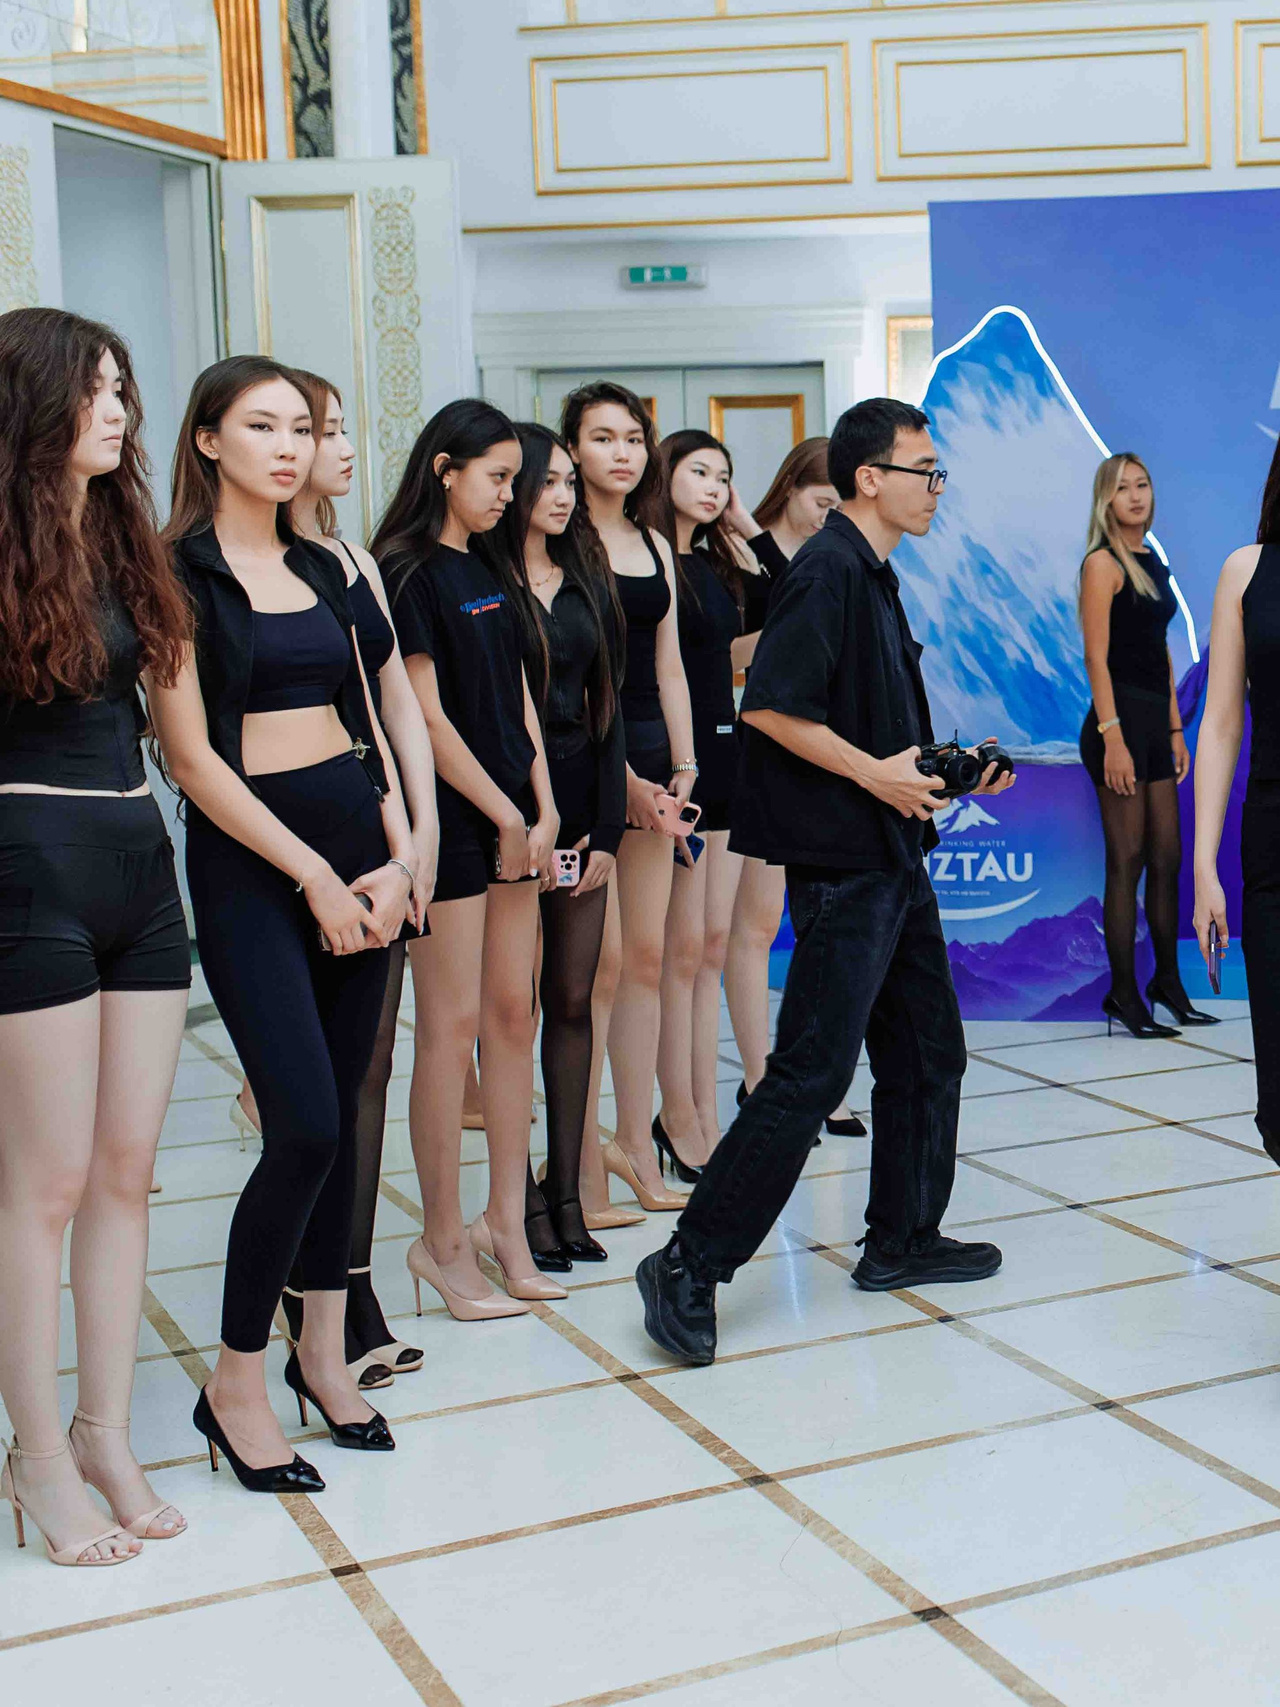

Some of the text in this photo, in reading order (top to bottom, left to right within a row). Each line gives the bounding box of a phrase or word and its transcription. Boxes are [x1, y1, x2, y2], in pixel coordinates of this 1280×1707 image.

[939, 840, 1006, 849] RINKING WATER
[922, 850, 1034, 882] ZTAU
